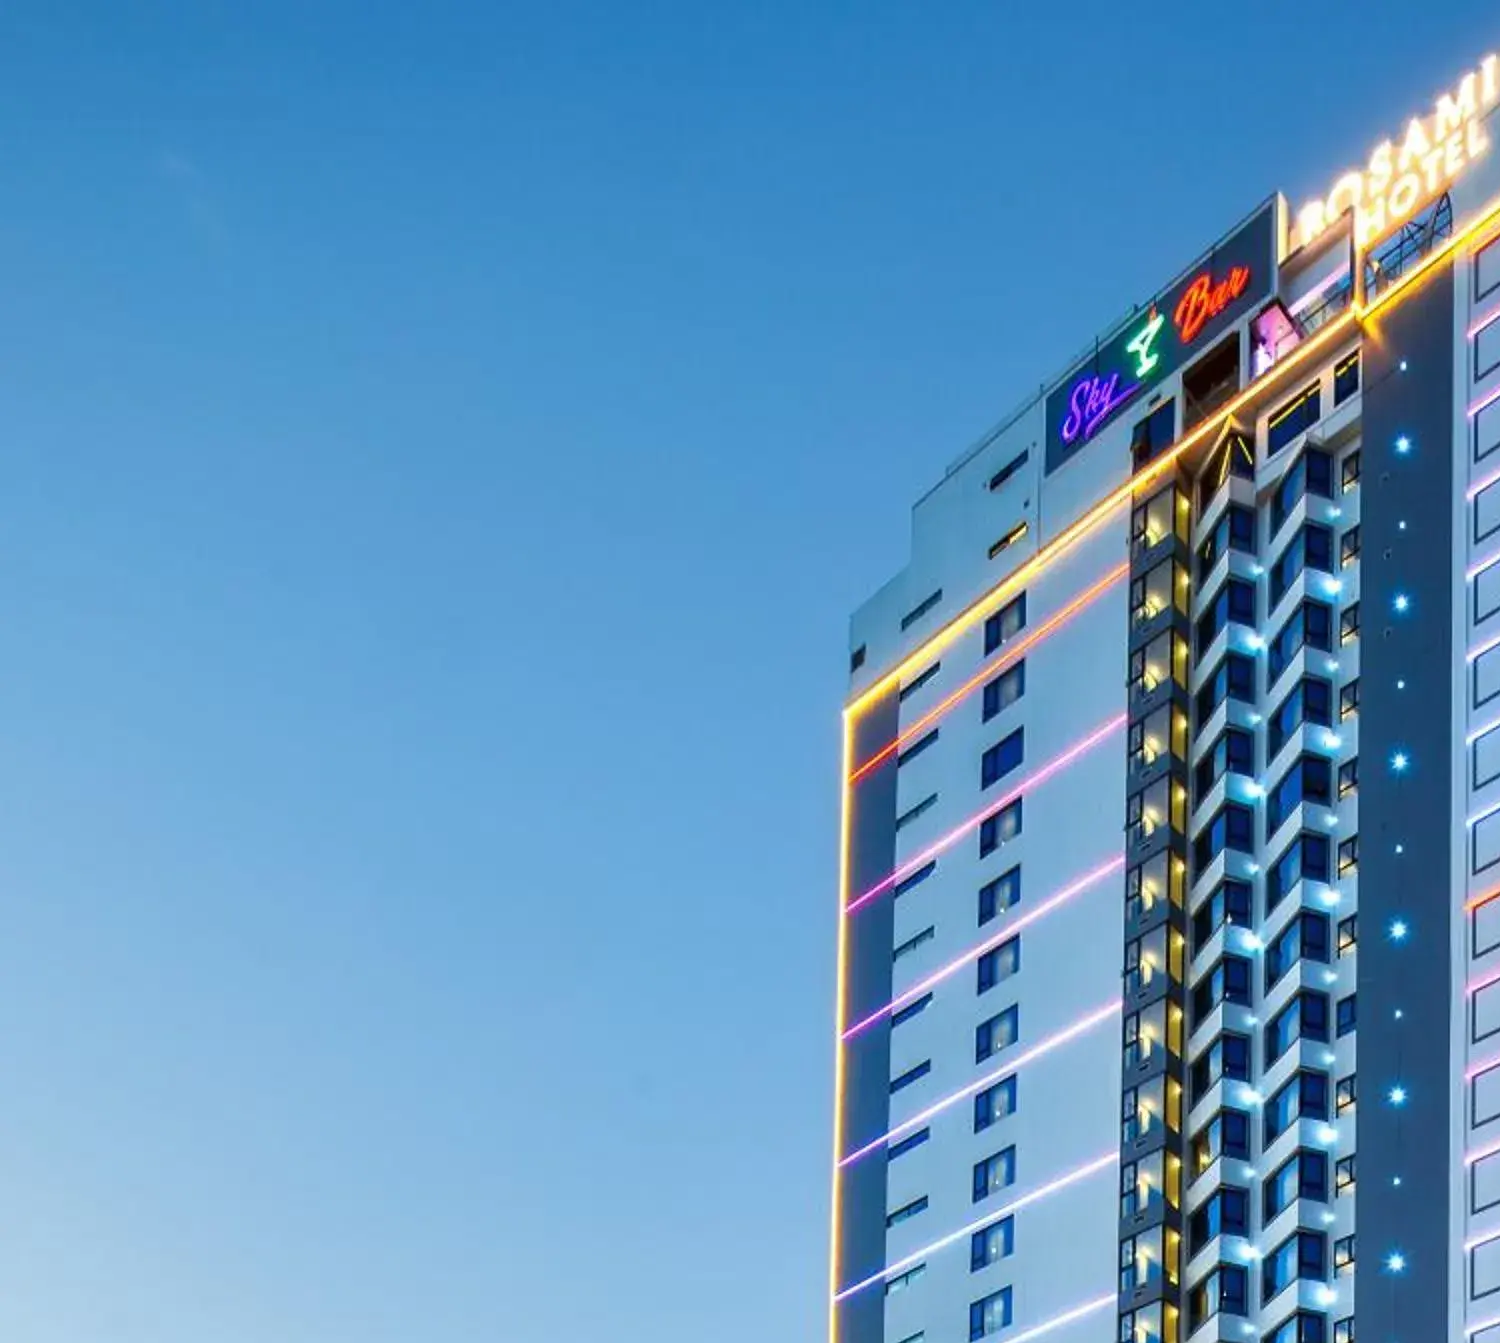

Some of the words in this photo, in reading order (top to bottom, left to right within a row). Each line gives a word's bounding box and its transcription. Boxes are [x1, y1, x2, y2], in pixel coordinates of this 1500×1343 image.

[1354, 116, 1490, 247] HOTEL
[1061, 373, 1141, 443] Sky
[1172, 265, 1249, 344] Bar
